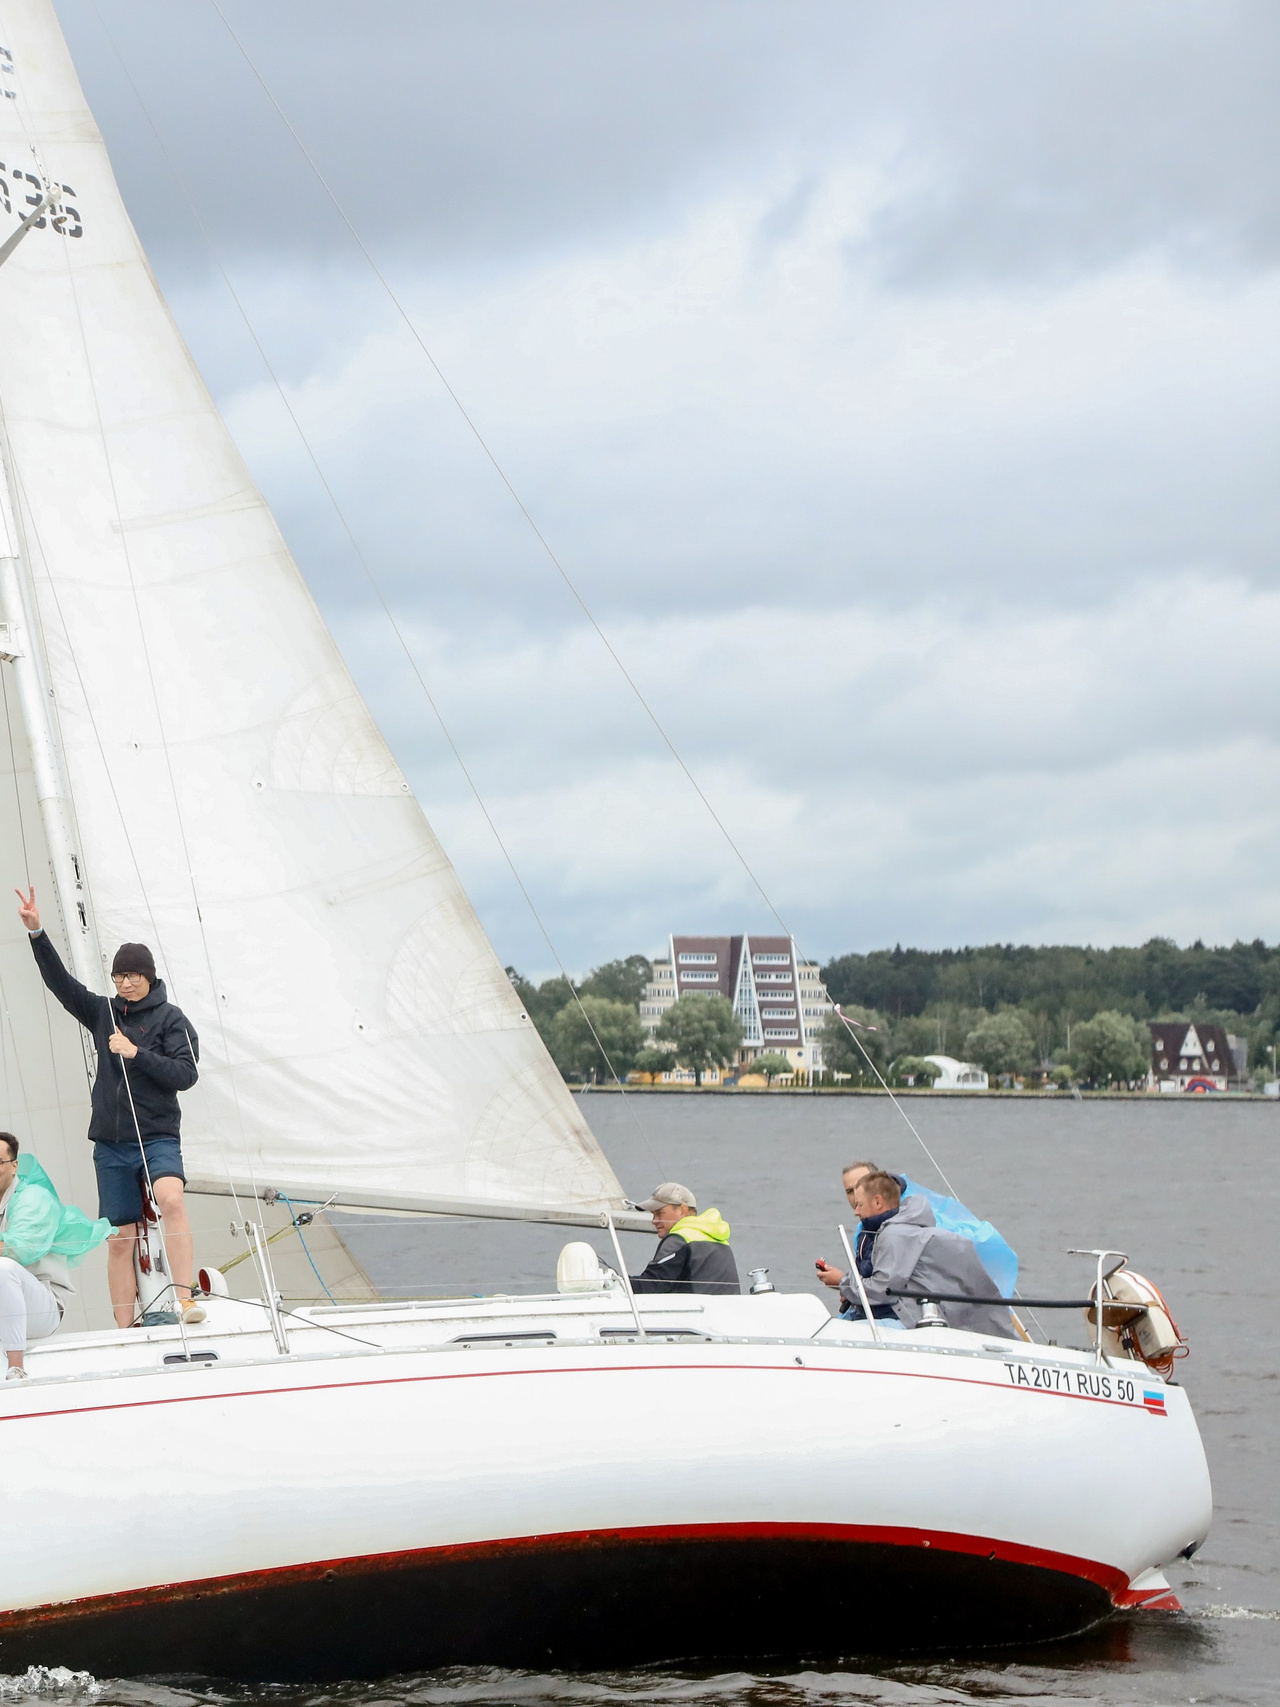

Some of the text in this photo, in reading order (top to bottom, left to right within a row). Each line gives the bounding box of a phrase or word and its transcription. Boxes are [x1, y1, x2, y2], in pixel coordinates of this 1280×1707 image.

[1004, 1363, 1135, 1402] TA 2071 RUS 50
